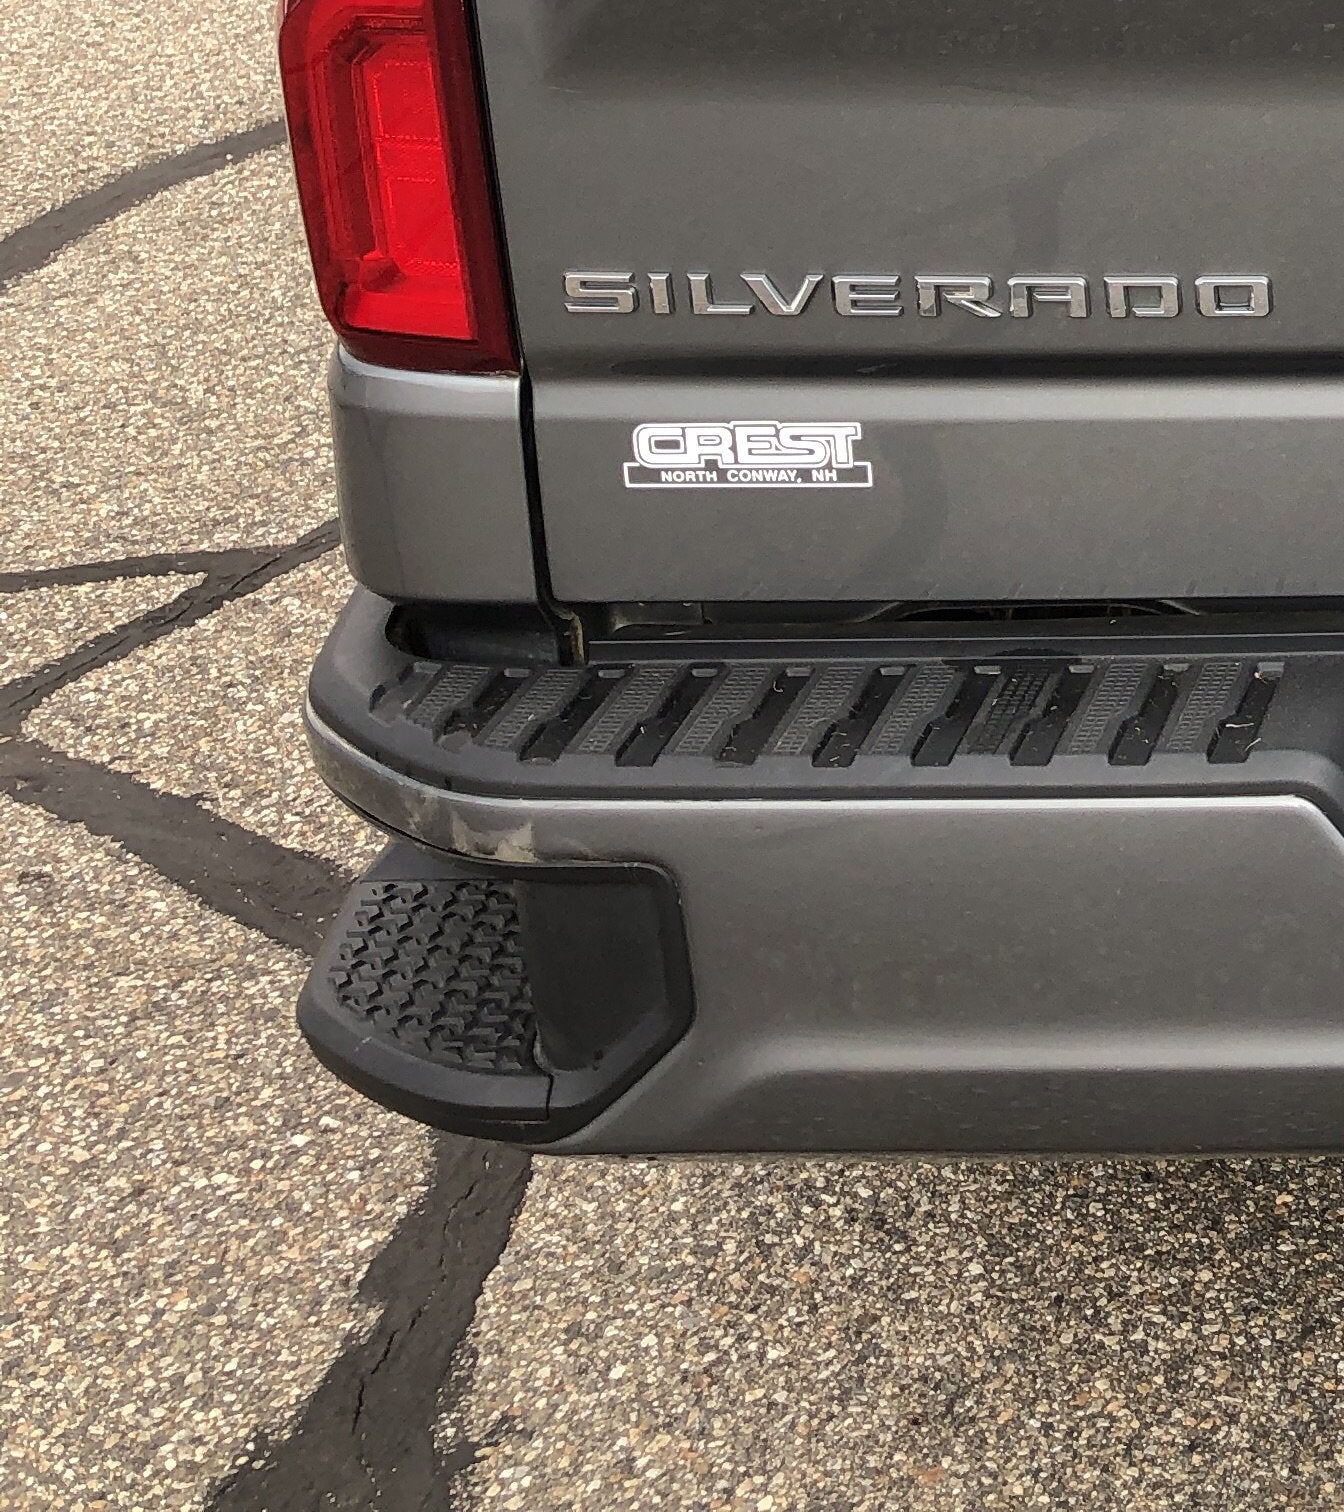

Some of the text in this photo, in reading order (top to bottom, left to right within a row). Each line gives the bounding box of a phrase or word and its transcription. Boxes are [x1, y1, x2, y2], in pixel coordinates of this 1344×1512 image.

[562, 271, 1272, 317] SILVERADO
[632, 421, 861, 467] CREST
[660, 469, 838, 483] NORTH CONWAY, NH
